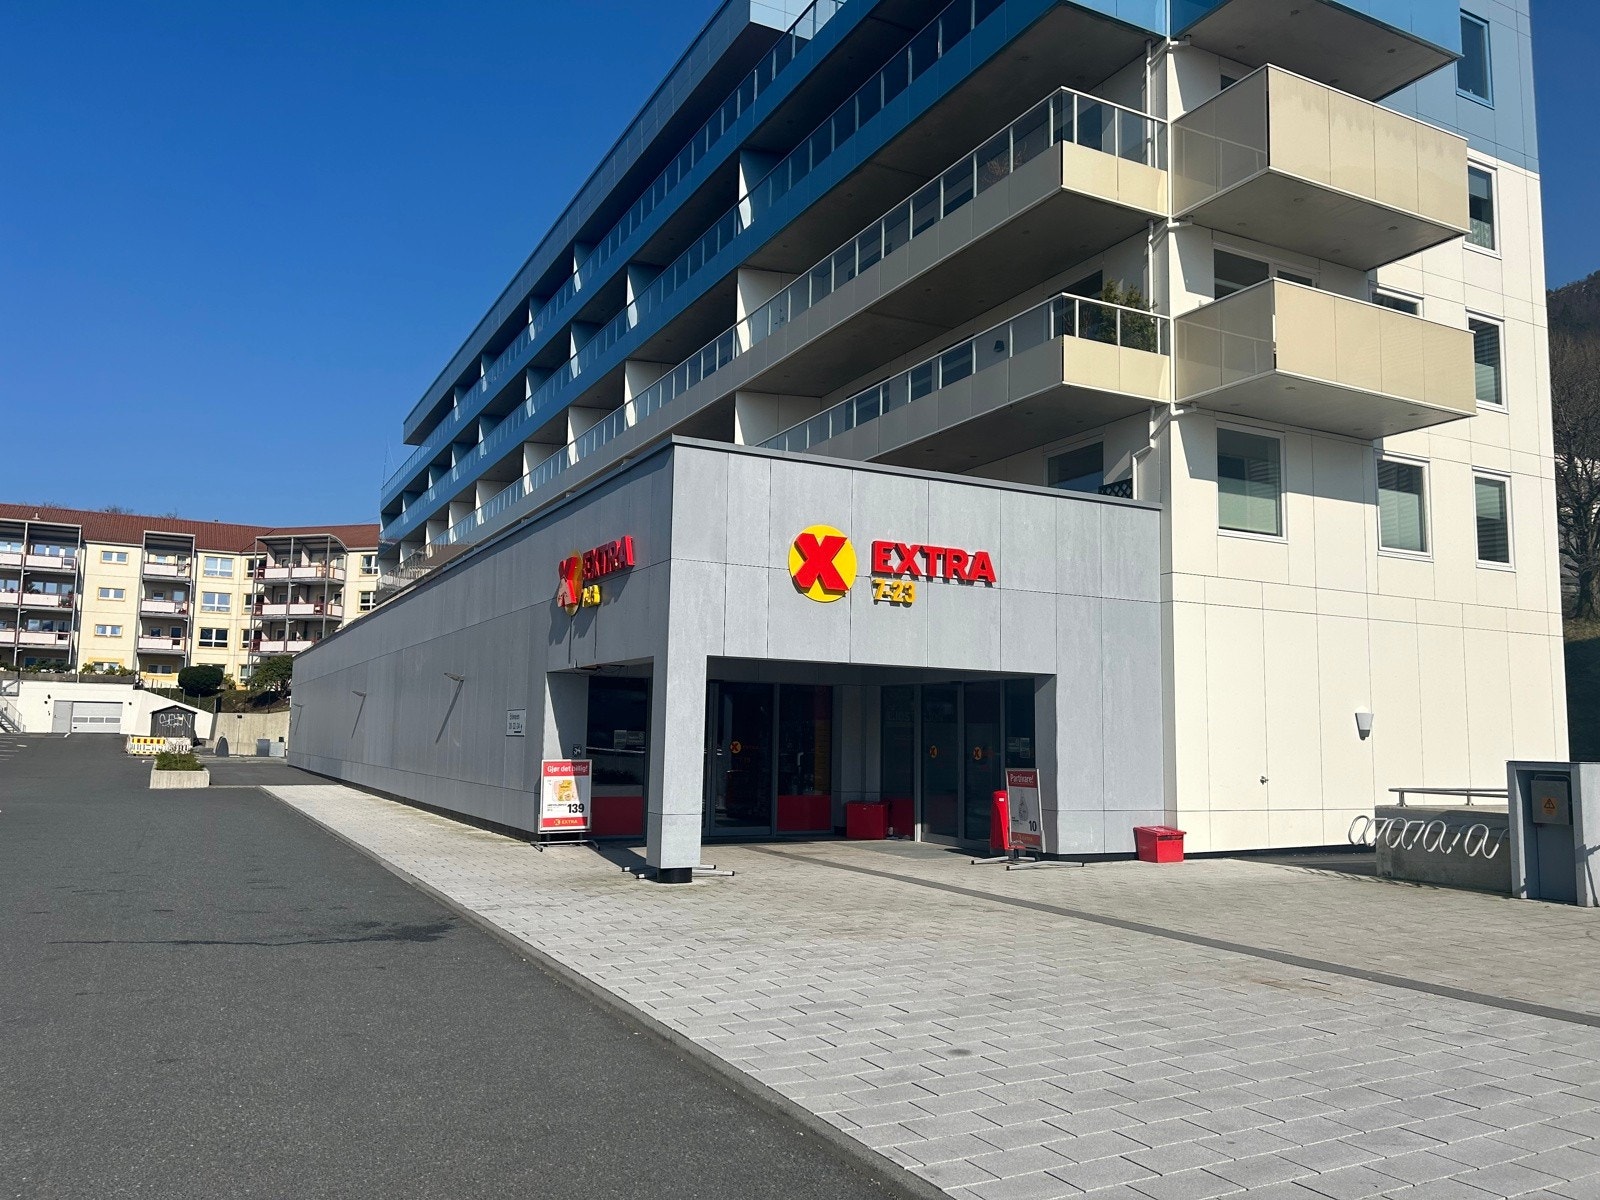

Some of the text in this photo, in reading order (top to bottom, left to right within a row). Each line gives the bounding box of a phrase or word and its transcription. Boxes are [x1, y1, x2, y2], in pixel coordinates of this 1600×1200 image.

[582, 535, 636, 580] EXTRA
[871, 540, 997, 587] EXTRA
[872, 577, 917, 607] 7-23
[560, 764, 571, 773] det
[567, 803, 584, 813] 139
[1029, 820, 1037, 831] 10
